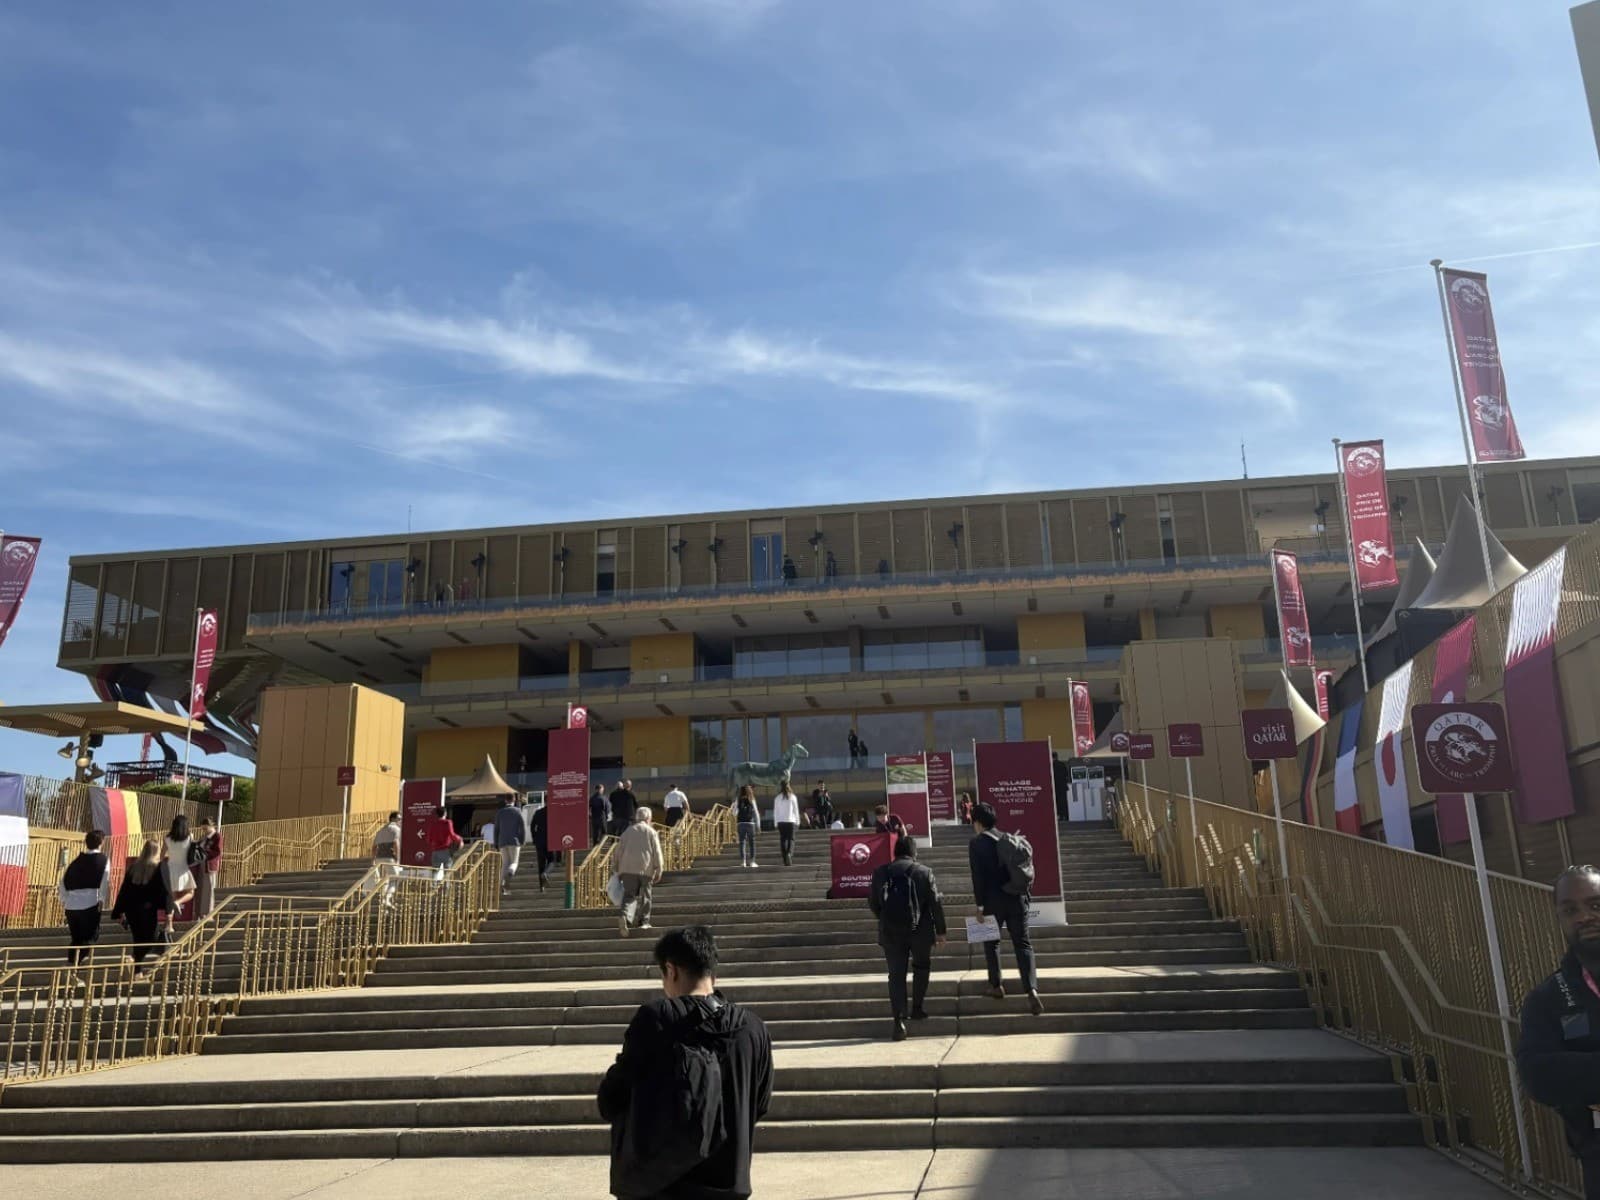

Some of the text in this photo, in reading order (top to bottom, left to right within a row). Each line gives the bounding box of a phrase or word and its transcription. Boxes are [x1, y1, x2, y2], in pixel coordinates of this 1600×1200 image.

[1261, 723, 1286, 734] visit
[1433, 713, 1485, 732] QATAR
[1253, 732, 1288, 745] QATAR
